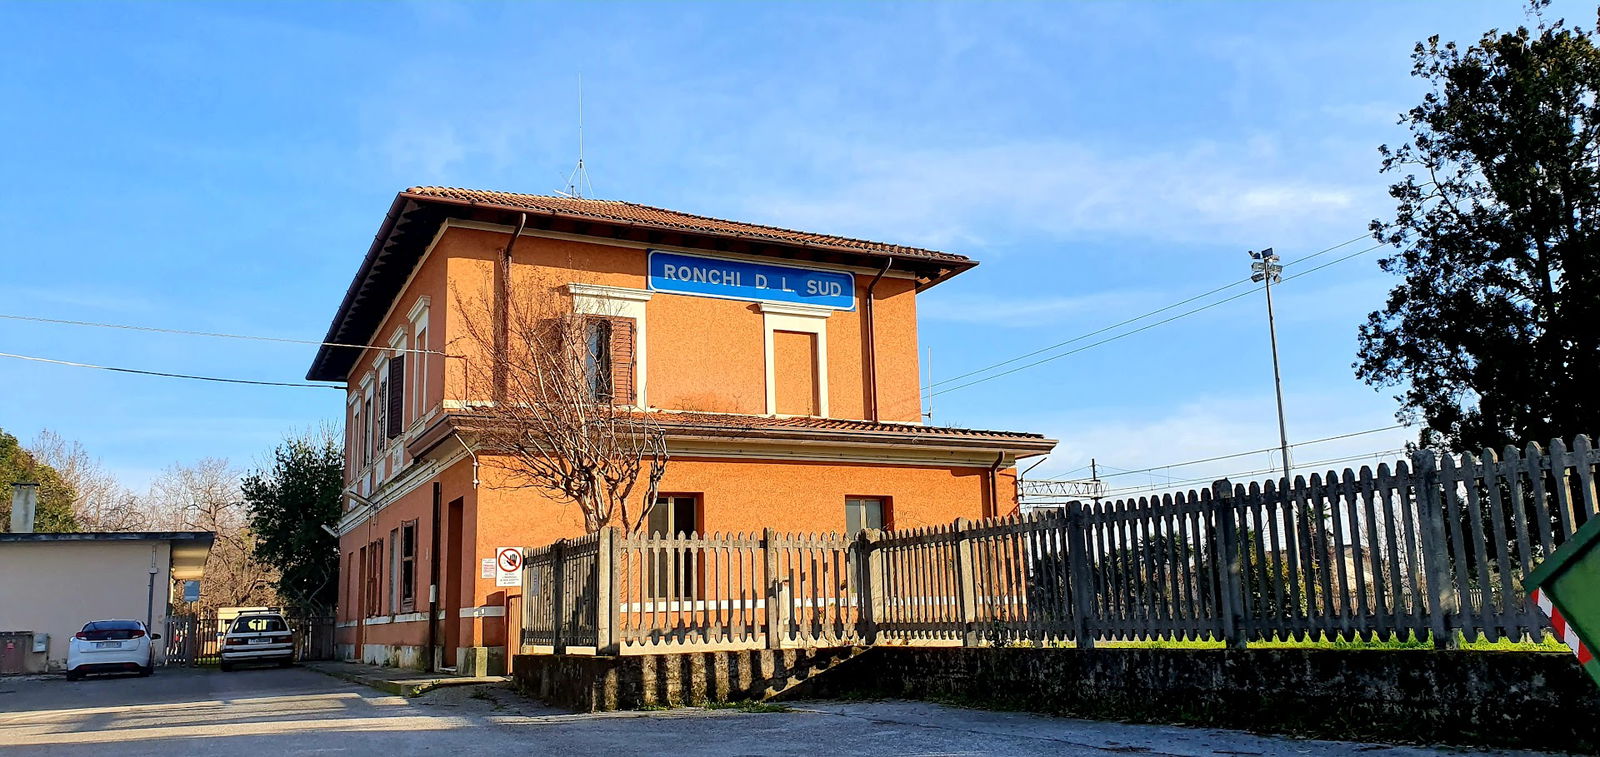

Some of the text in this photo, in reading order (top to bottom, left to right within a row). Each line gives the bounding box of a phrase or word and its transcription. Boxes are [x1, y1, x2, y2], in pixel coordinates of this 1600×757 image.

[664, 264, 842, 297] RONCHI D. L. SUD
